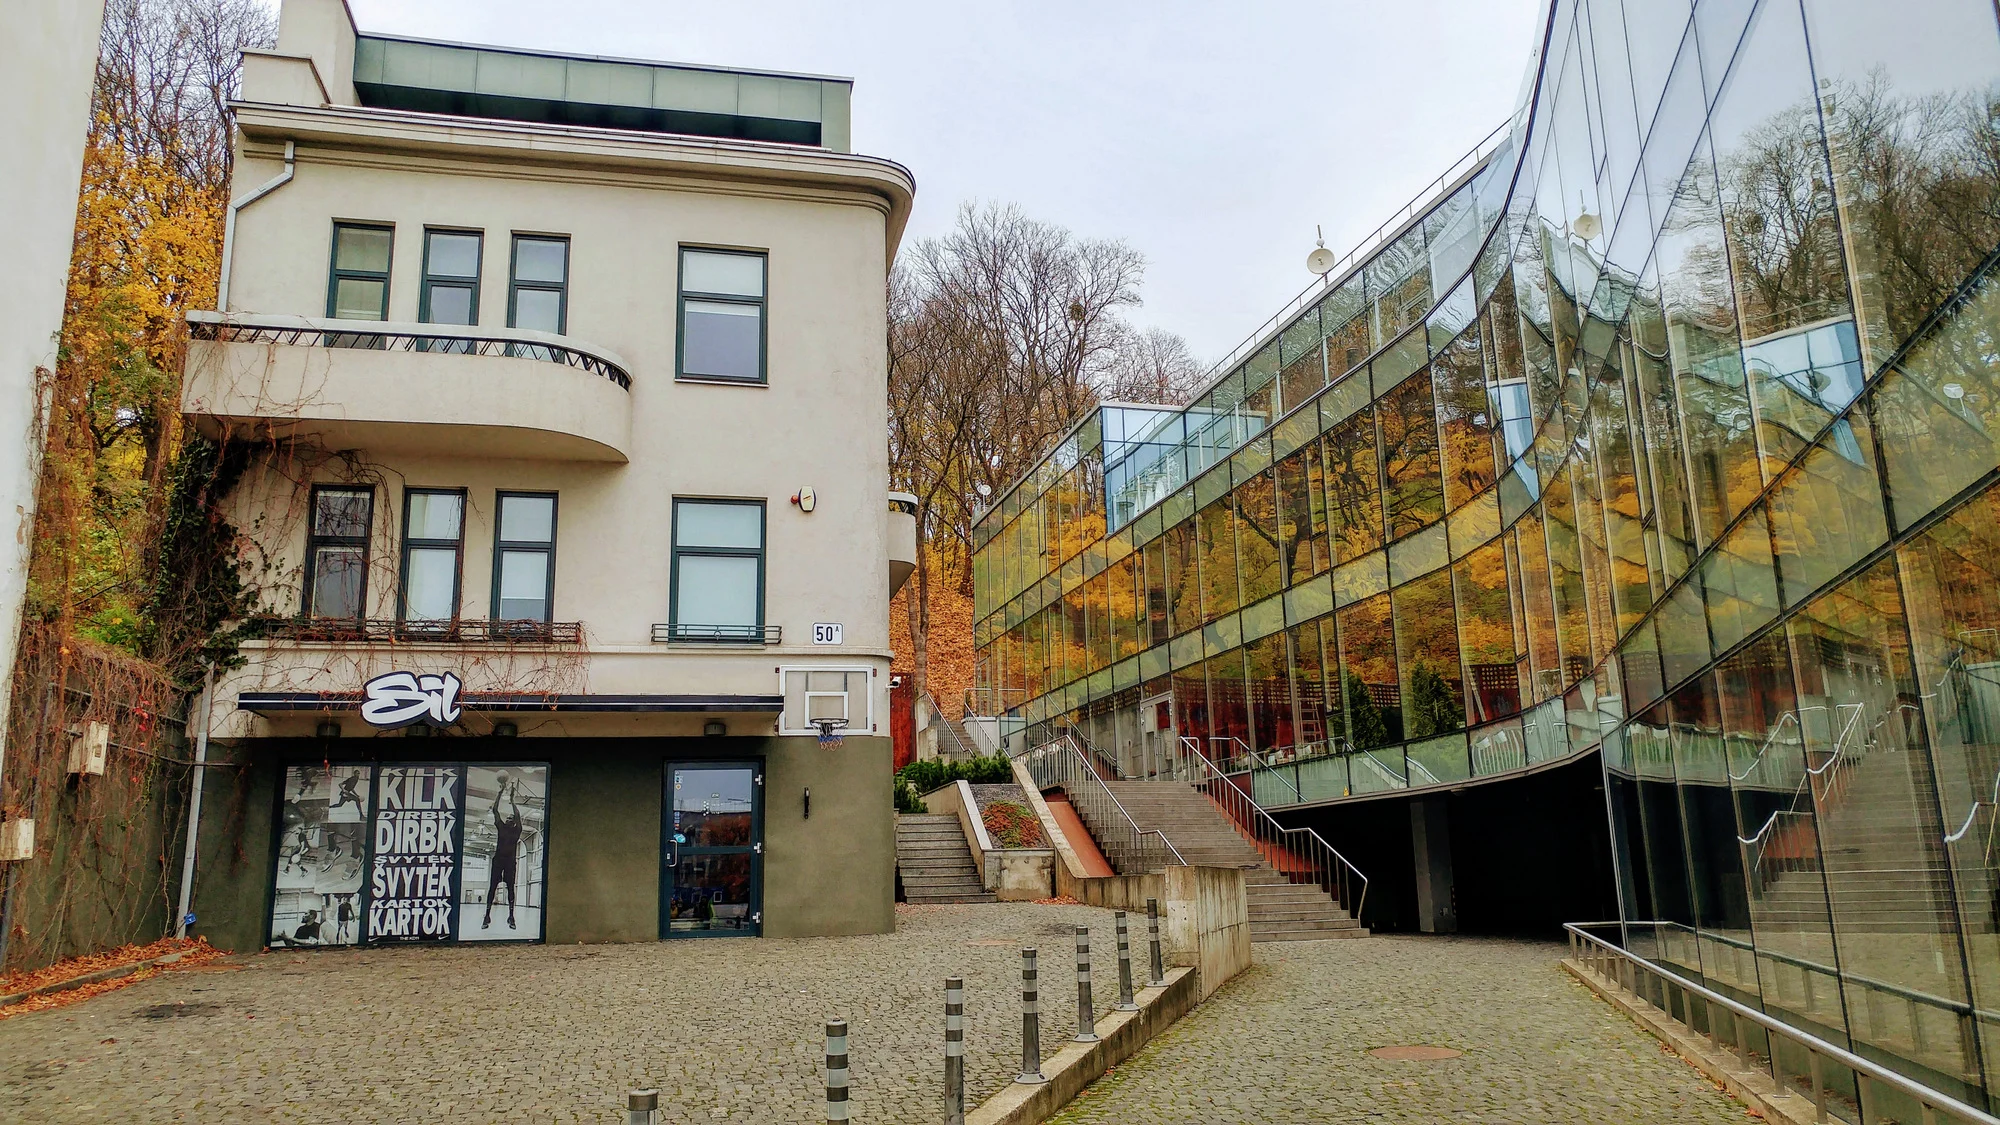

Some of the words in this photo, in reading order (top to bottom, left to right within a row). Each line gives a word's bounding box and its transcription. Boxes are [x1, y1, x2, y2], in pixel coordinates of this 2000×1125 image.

[379, 776, 458, 810] KILK
[375, 819, 456, 854] DIRBK
[372, 863, 453, 898] ŠVYTĖK
[368, 908, 452, 936] KARTOK
